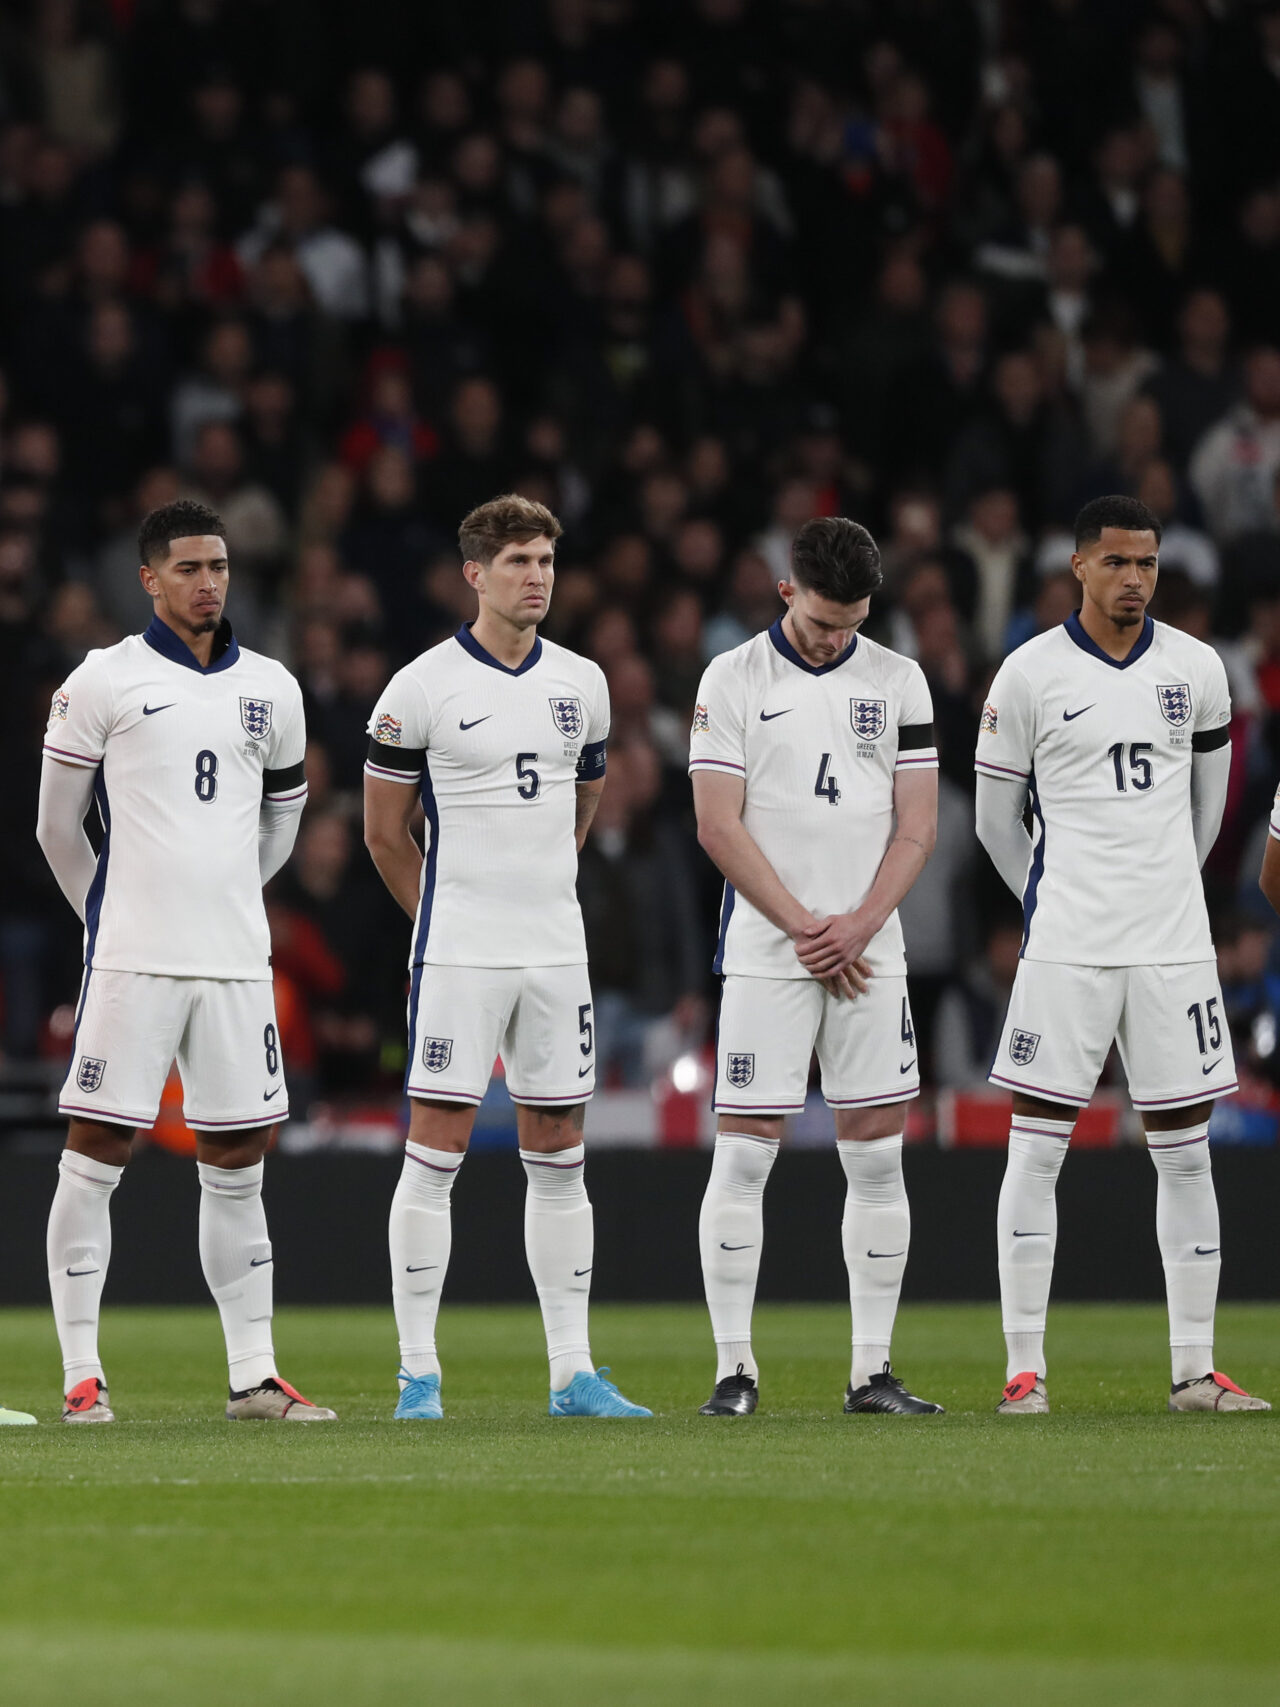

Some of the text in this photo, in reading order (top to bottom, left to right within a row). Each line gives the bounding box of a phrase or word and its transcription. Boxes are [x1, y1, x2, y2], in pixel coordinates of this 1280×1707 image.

[856, 742, 877, 751] GREECE
[1107, 741, 1155, 792] 15
[194, 748, 219, 803] 8
[515, 752, 542, 801] 5
[814, 752, 841, 805] 4
[578, 1002, 593, 1058] 5
[900, 996, 915, 1048] 4
[1186, 996, 1223, 1056] 15
[263, 1022, 280, 1078] 8
